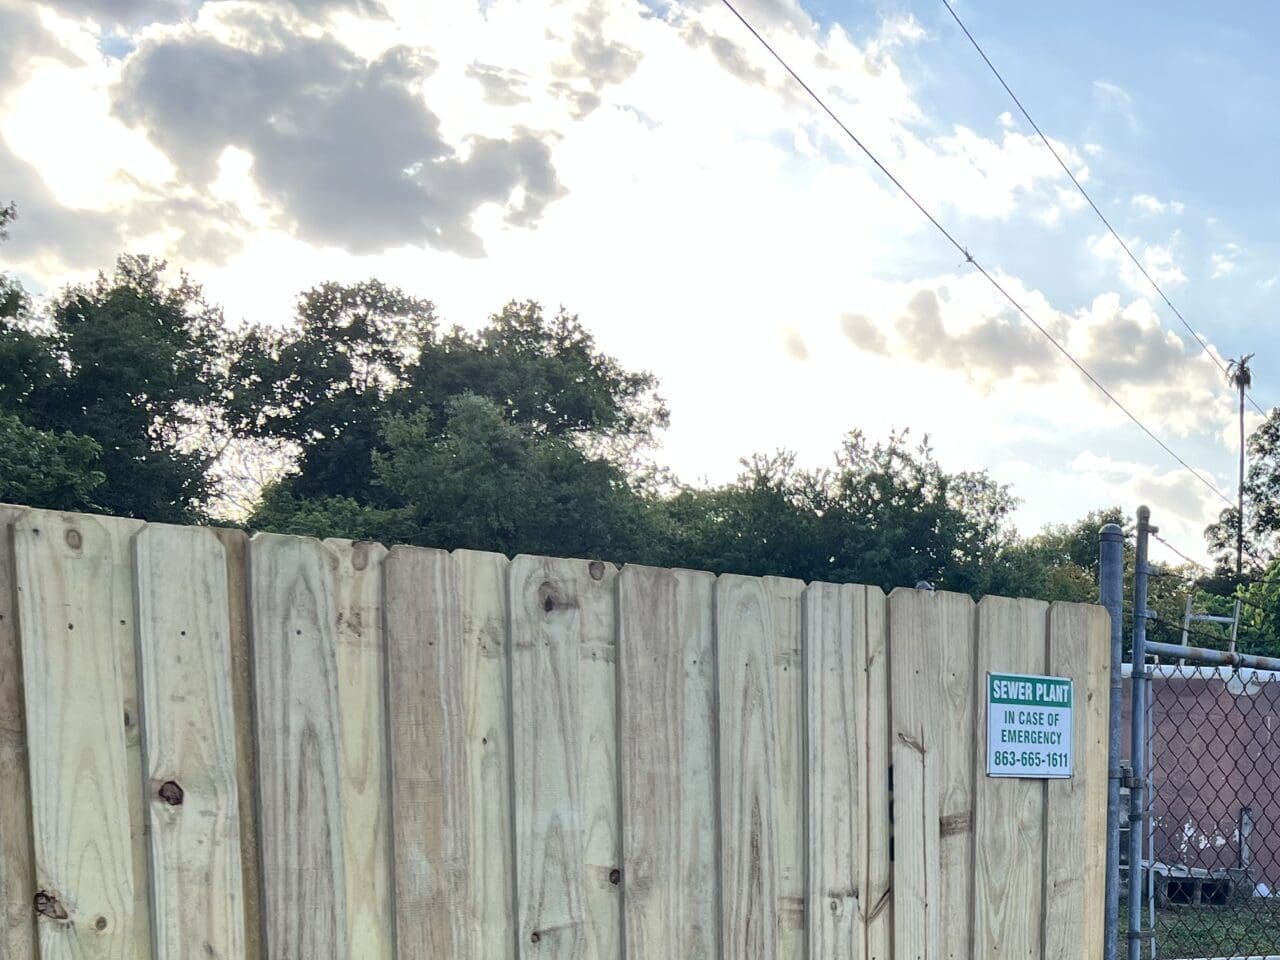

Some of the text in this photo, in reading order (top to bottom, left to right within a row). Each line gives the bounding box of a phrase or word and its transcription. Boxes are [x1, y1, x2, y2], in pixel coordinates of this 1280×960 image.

[993, 680, 1069, 703] SEWER PLANT
[1004, 710, 1060, 727] IN CASE OF
[1001, 729, 1062, 745] EMERGENCY
[994, 750, 1068, 768] 863-665-1611
